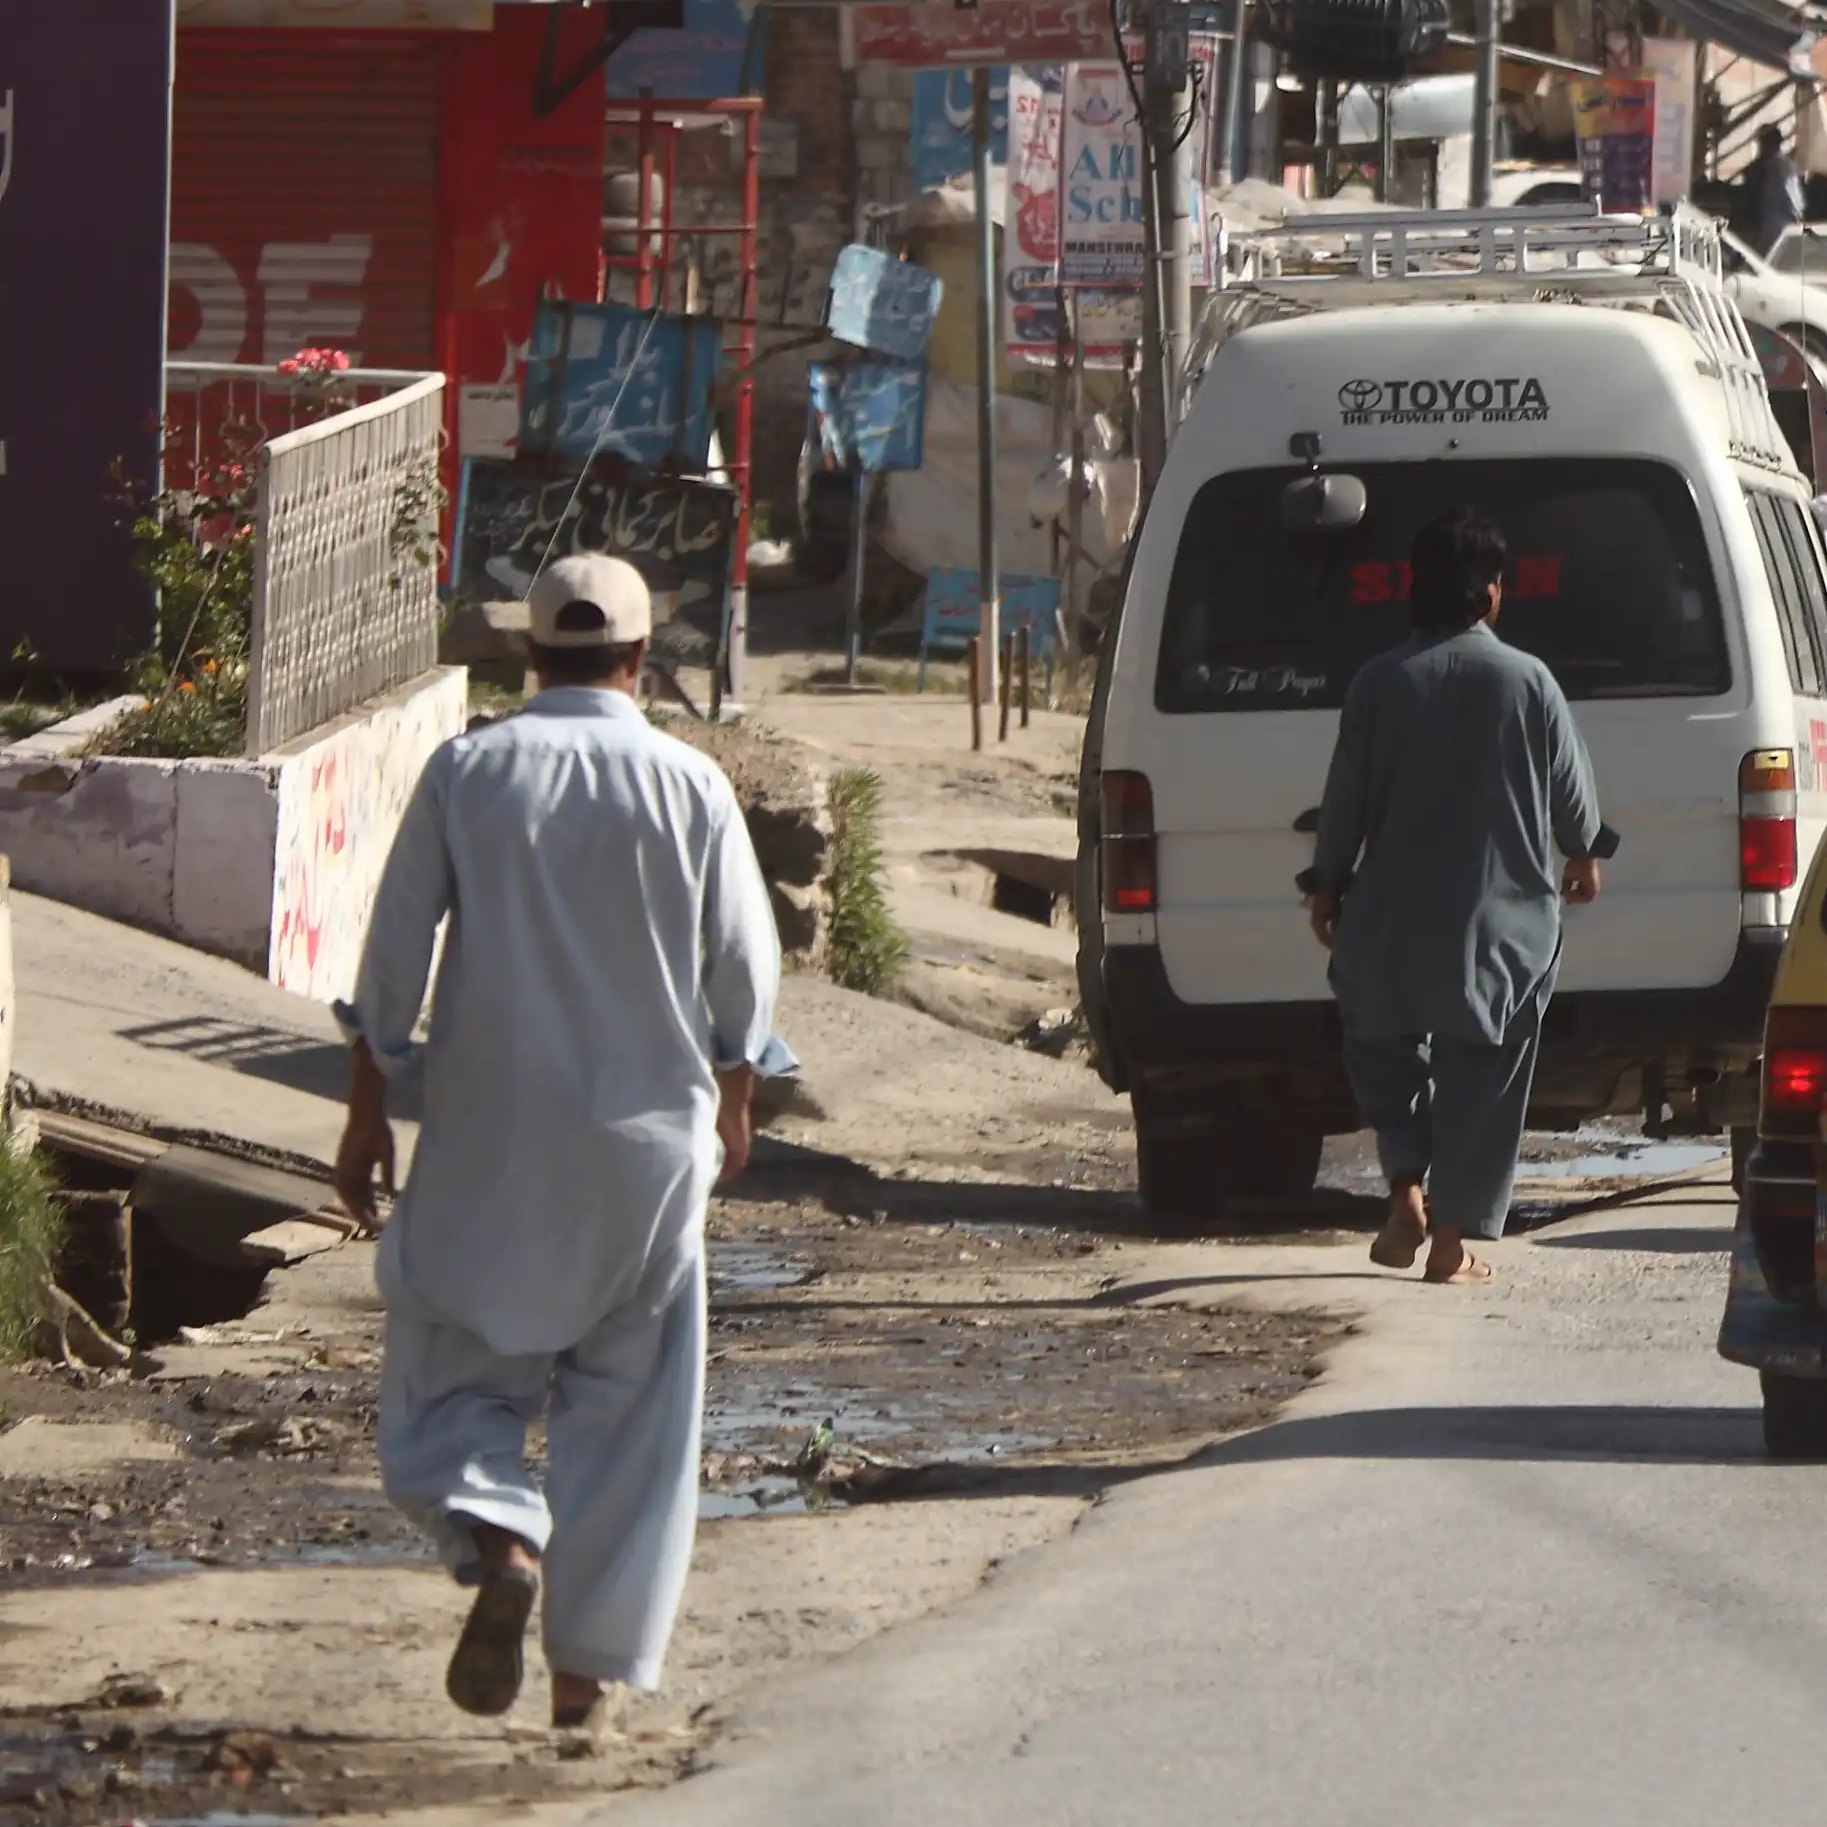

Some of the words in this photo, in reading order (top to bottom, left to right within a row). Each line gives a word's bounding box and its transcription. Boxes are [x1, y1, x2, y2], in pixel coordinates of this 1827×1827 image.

[1069, 143, 1136, 181] All
[1384, 377, 1548, 412] TOYOTA
[1342, 411, 1374, 426] THE
[1380, 410, 1445, 425] POWER
[1452, 409, 1477, 424] OF
[1482, 408, 1549, 423] DREAM
